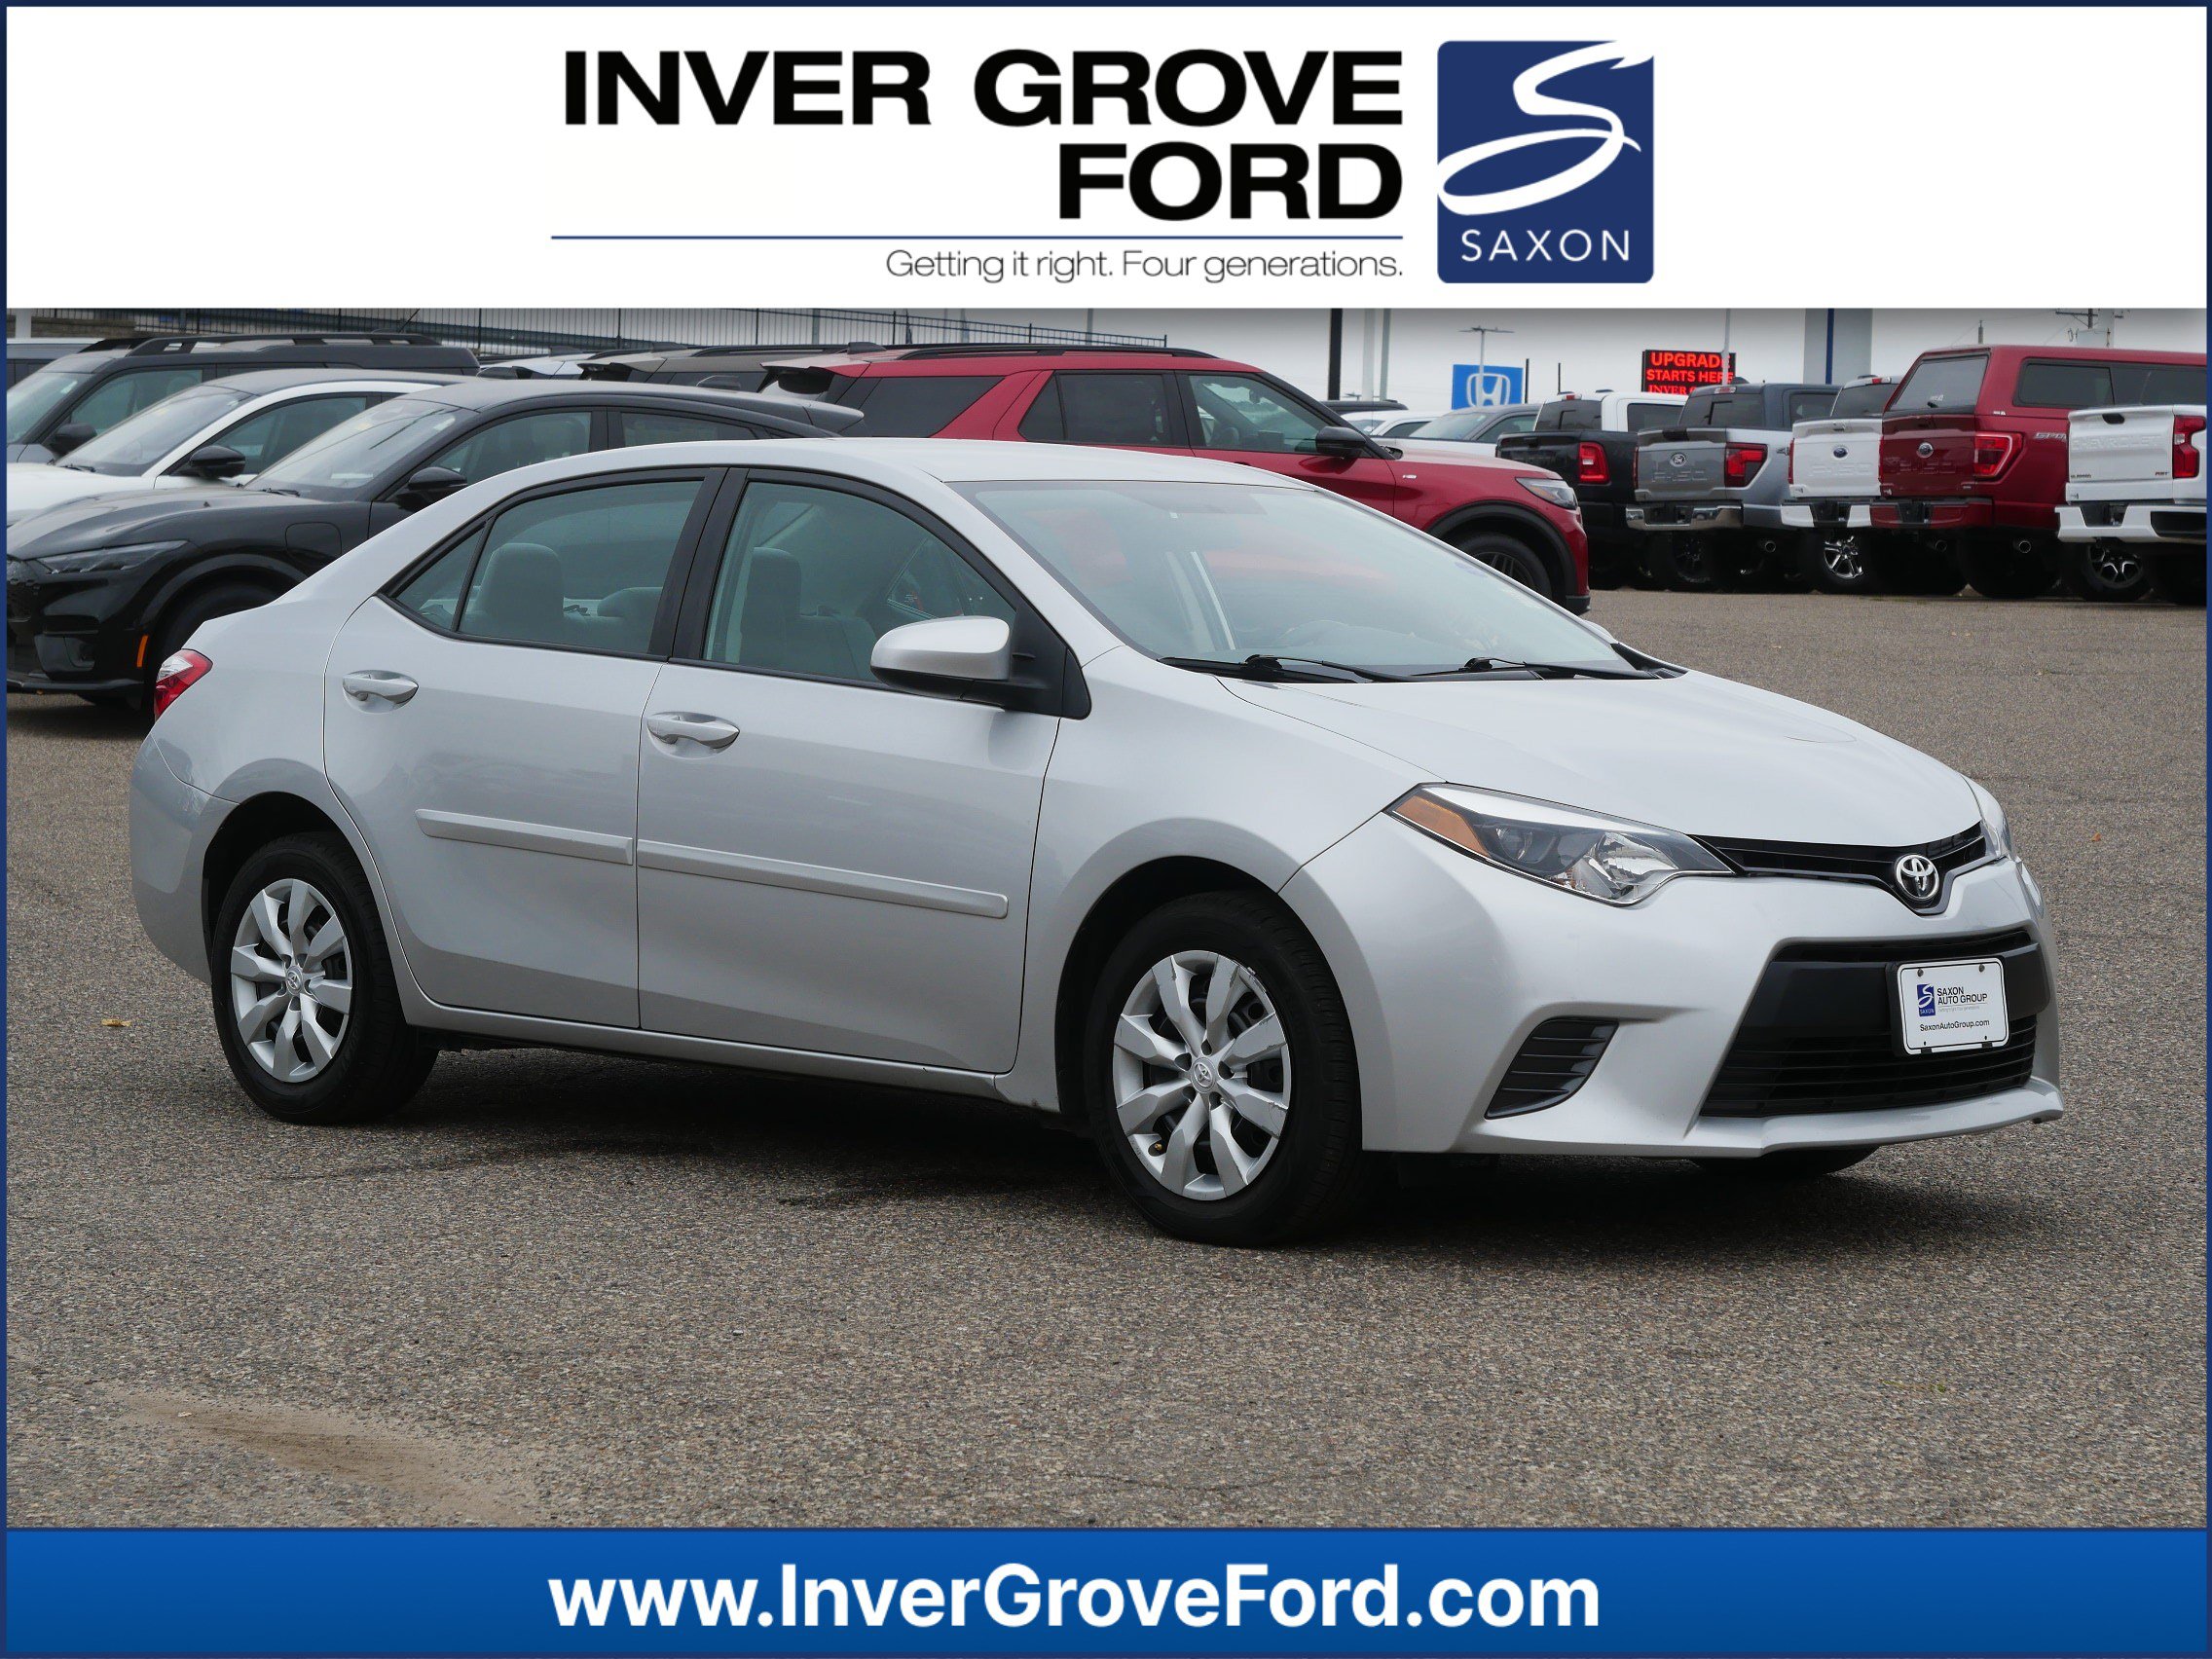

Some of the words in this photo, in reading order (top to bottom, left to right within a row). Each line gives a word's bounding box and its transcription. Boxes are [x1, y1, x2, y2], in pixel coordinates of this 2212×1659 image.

[1646, 368, 1696, 383] STARTS
[1936, 986, 1965, 997] SAXON
[1937, 995, 1959, 1005] AUTO
[1960, 993, 1987, 1003] GROUP
[1920, 1019, 1990, 1032] SaxonAutoGroup.com
